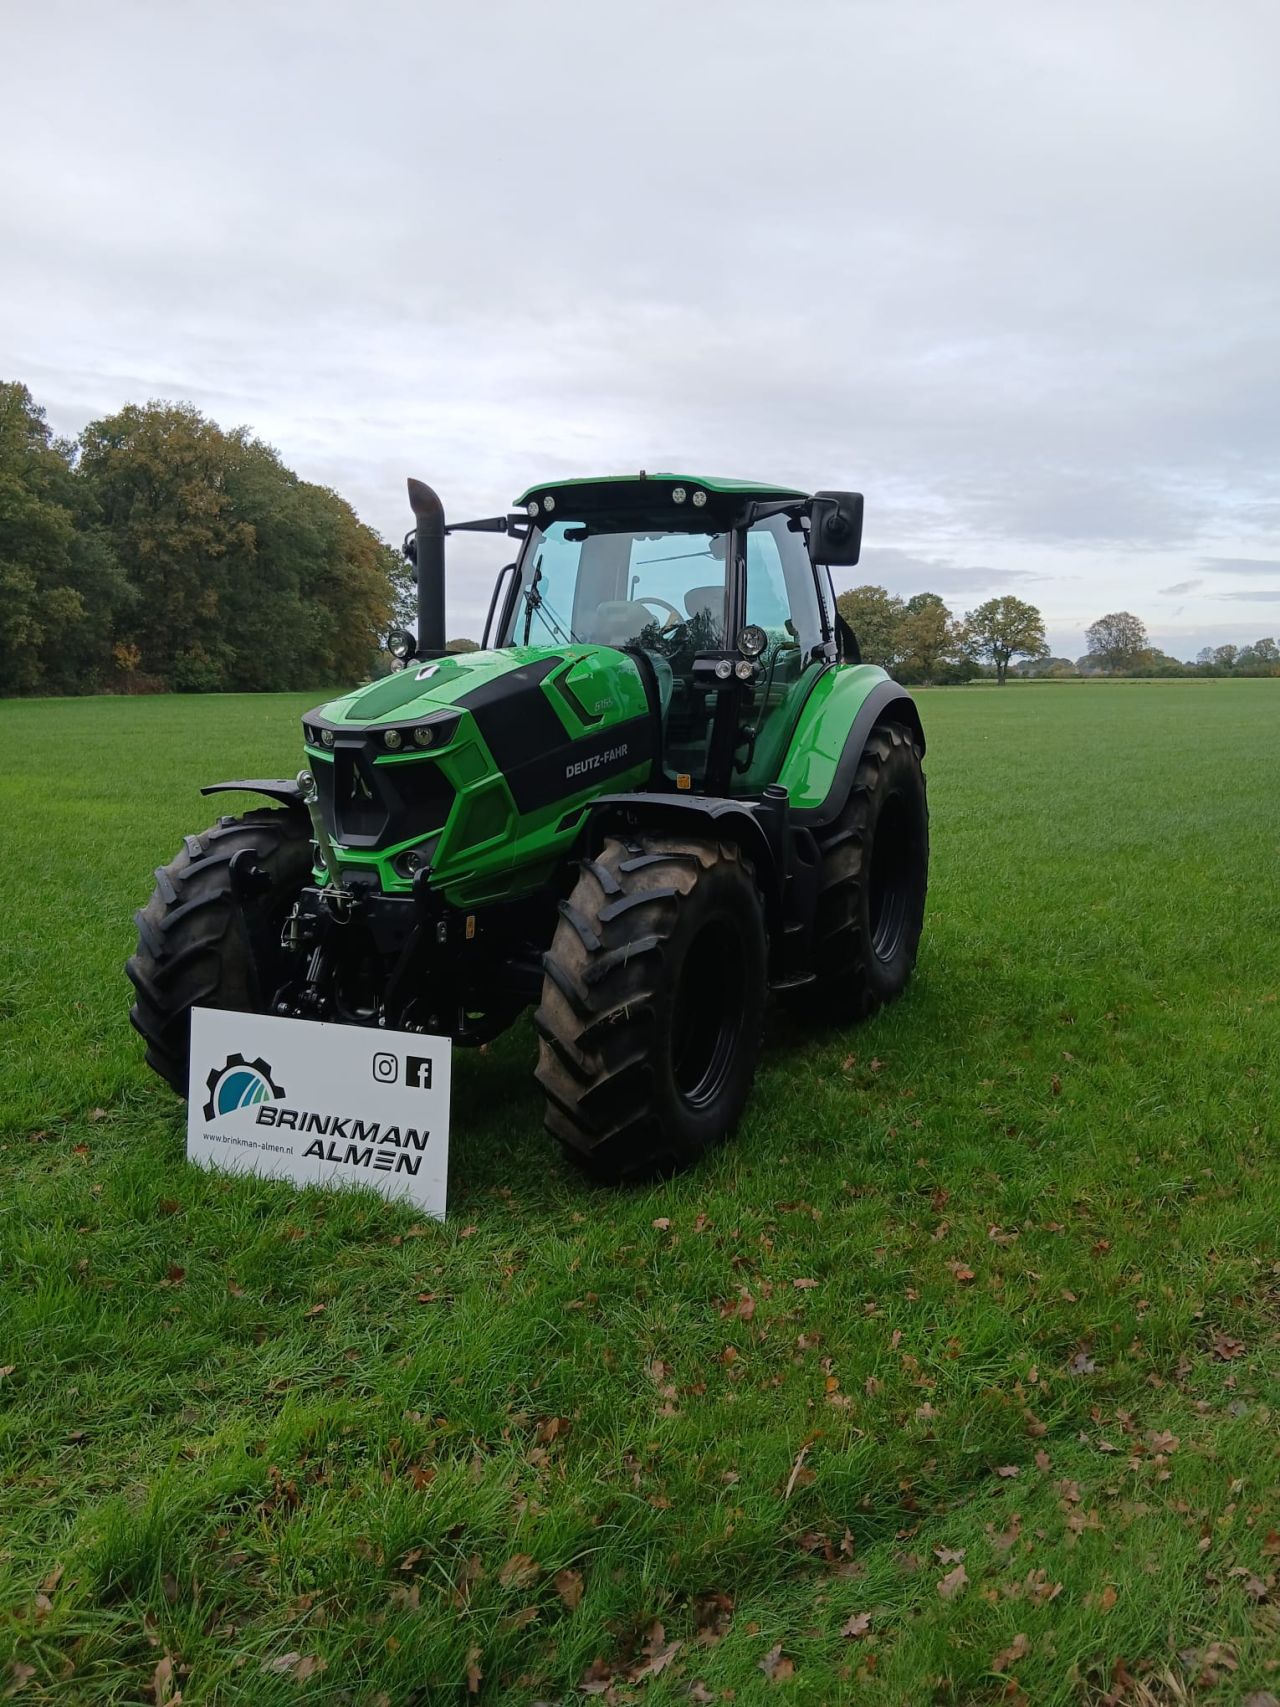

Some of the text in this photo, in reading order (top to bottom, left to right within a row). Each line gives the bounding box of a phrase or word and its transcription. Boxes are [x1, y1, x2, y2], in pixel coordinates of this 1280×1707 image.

[566, 743, 628, 779] DEUTZ-FAHR
[203, 1132, 294, 1155] www.brinkman-almen.nl
[255, 1105, 430, 1151] BRINKMAN
[302, 1139, 422, 1176] ALMEN
